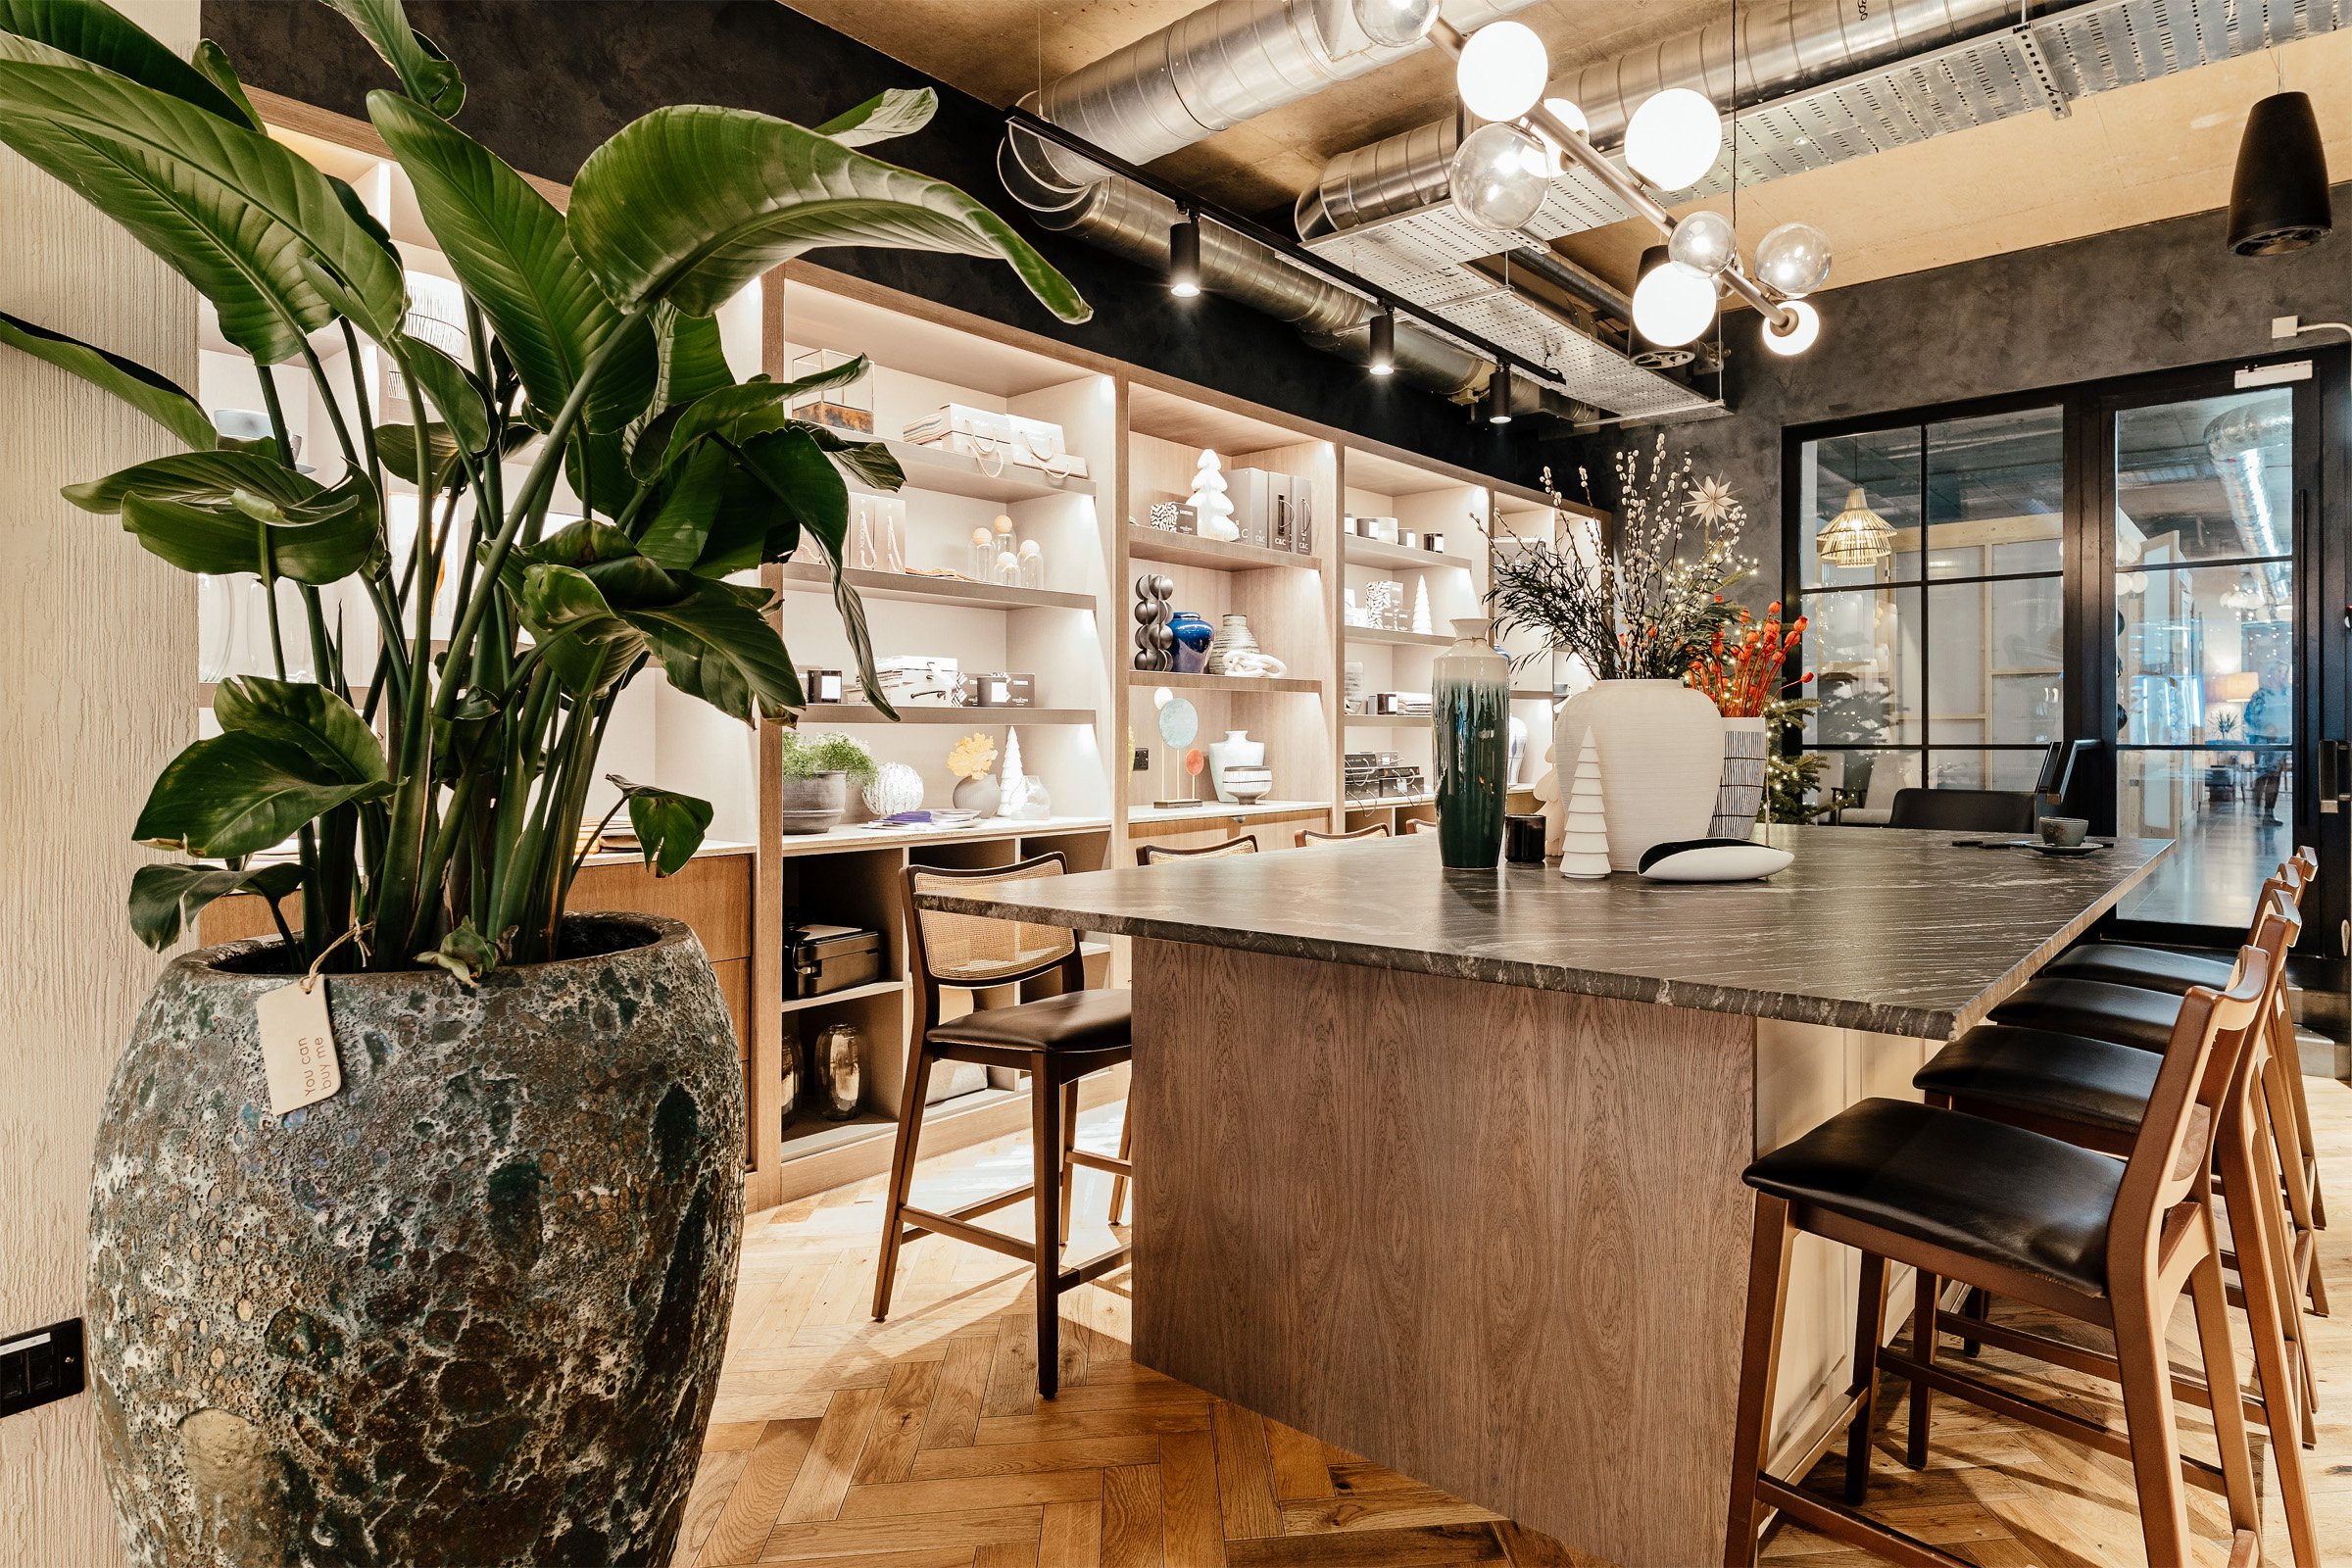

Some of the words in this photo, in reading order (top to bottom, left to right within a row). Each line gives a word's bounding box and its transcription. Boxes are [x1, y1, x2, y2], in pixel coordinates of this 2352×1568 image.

[298, 1037, 311, 1065] can
[314, 1036, 326, 1059] me
[319, 1064, 332, 1091] buy
